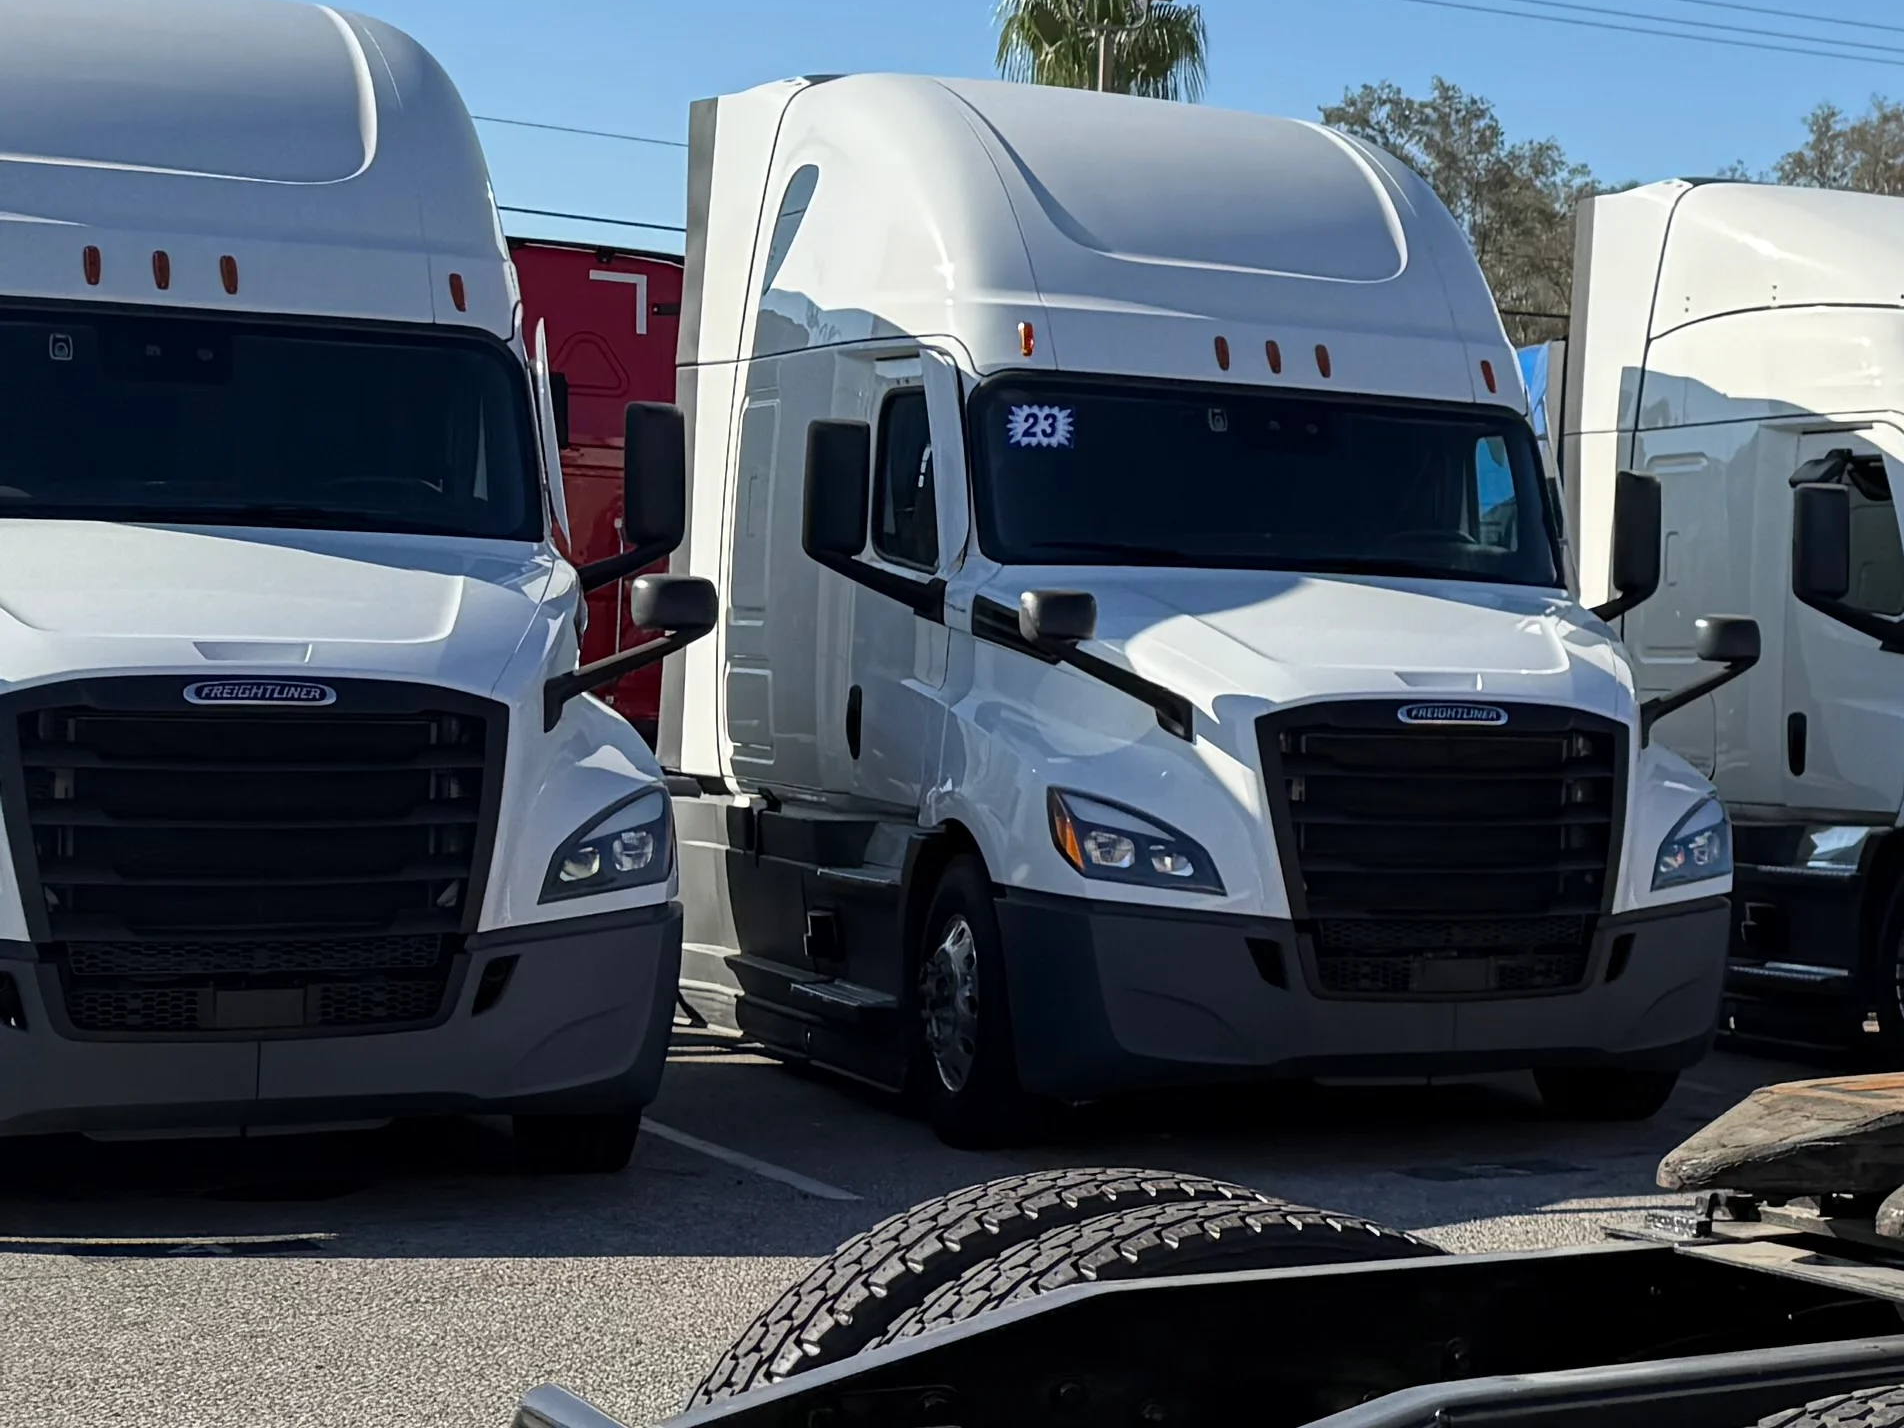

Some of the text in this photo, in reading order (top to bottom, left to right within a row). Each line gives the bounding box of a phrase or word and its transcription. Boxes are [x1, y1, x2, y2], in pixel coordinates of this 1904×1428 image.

[1021, 413, 1058, 438] 23
[200, 684, 322, 700] FREIGHTLINER
[1411, 707, 1498, 720] FREIGHTLINER
